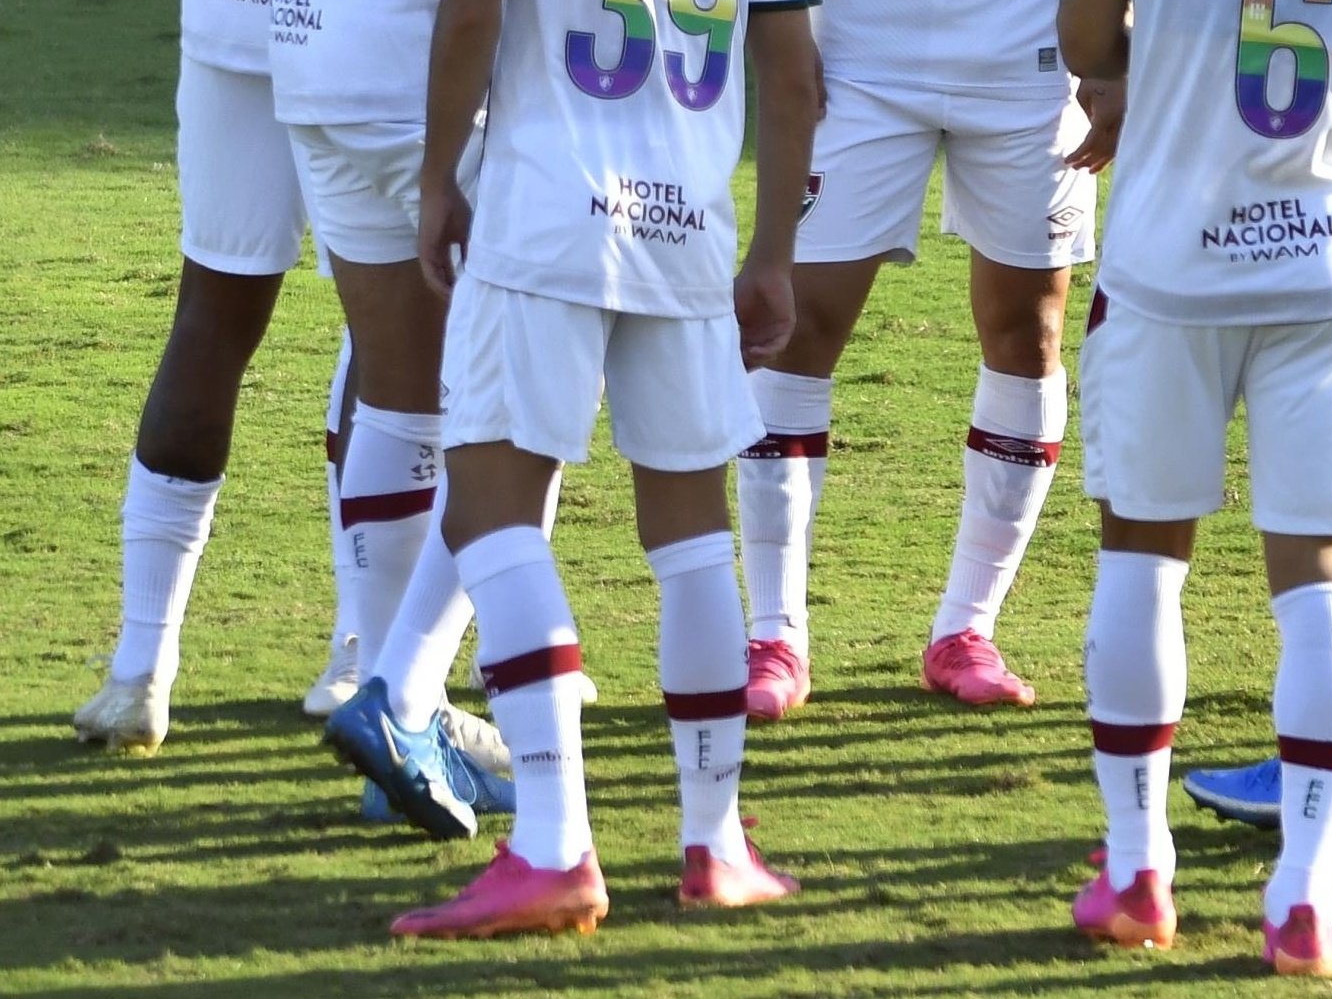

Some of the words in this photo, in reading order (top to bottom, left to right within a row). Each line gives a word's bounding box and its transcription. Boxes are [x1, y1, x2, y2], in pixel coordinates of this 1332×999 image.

[274, 7, 322, 30] CIONAL
[618, 177, 686, 205] HOTEL
[591, 196, 706, 230] NACIONAL
[1231, 199, 1306, 224] HOTEL
[632, 225, 687, 246] WAM
[1230, 253, 1246, 262] BY
[1251, 243, 1319, 262] WAM
